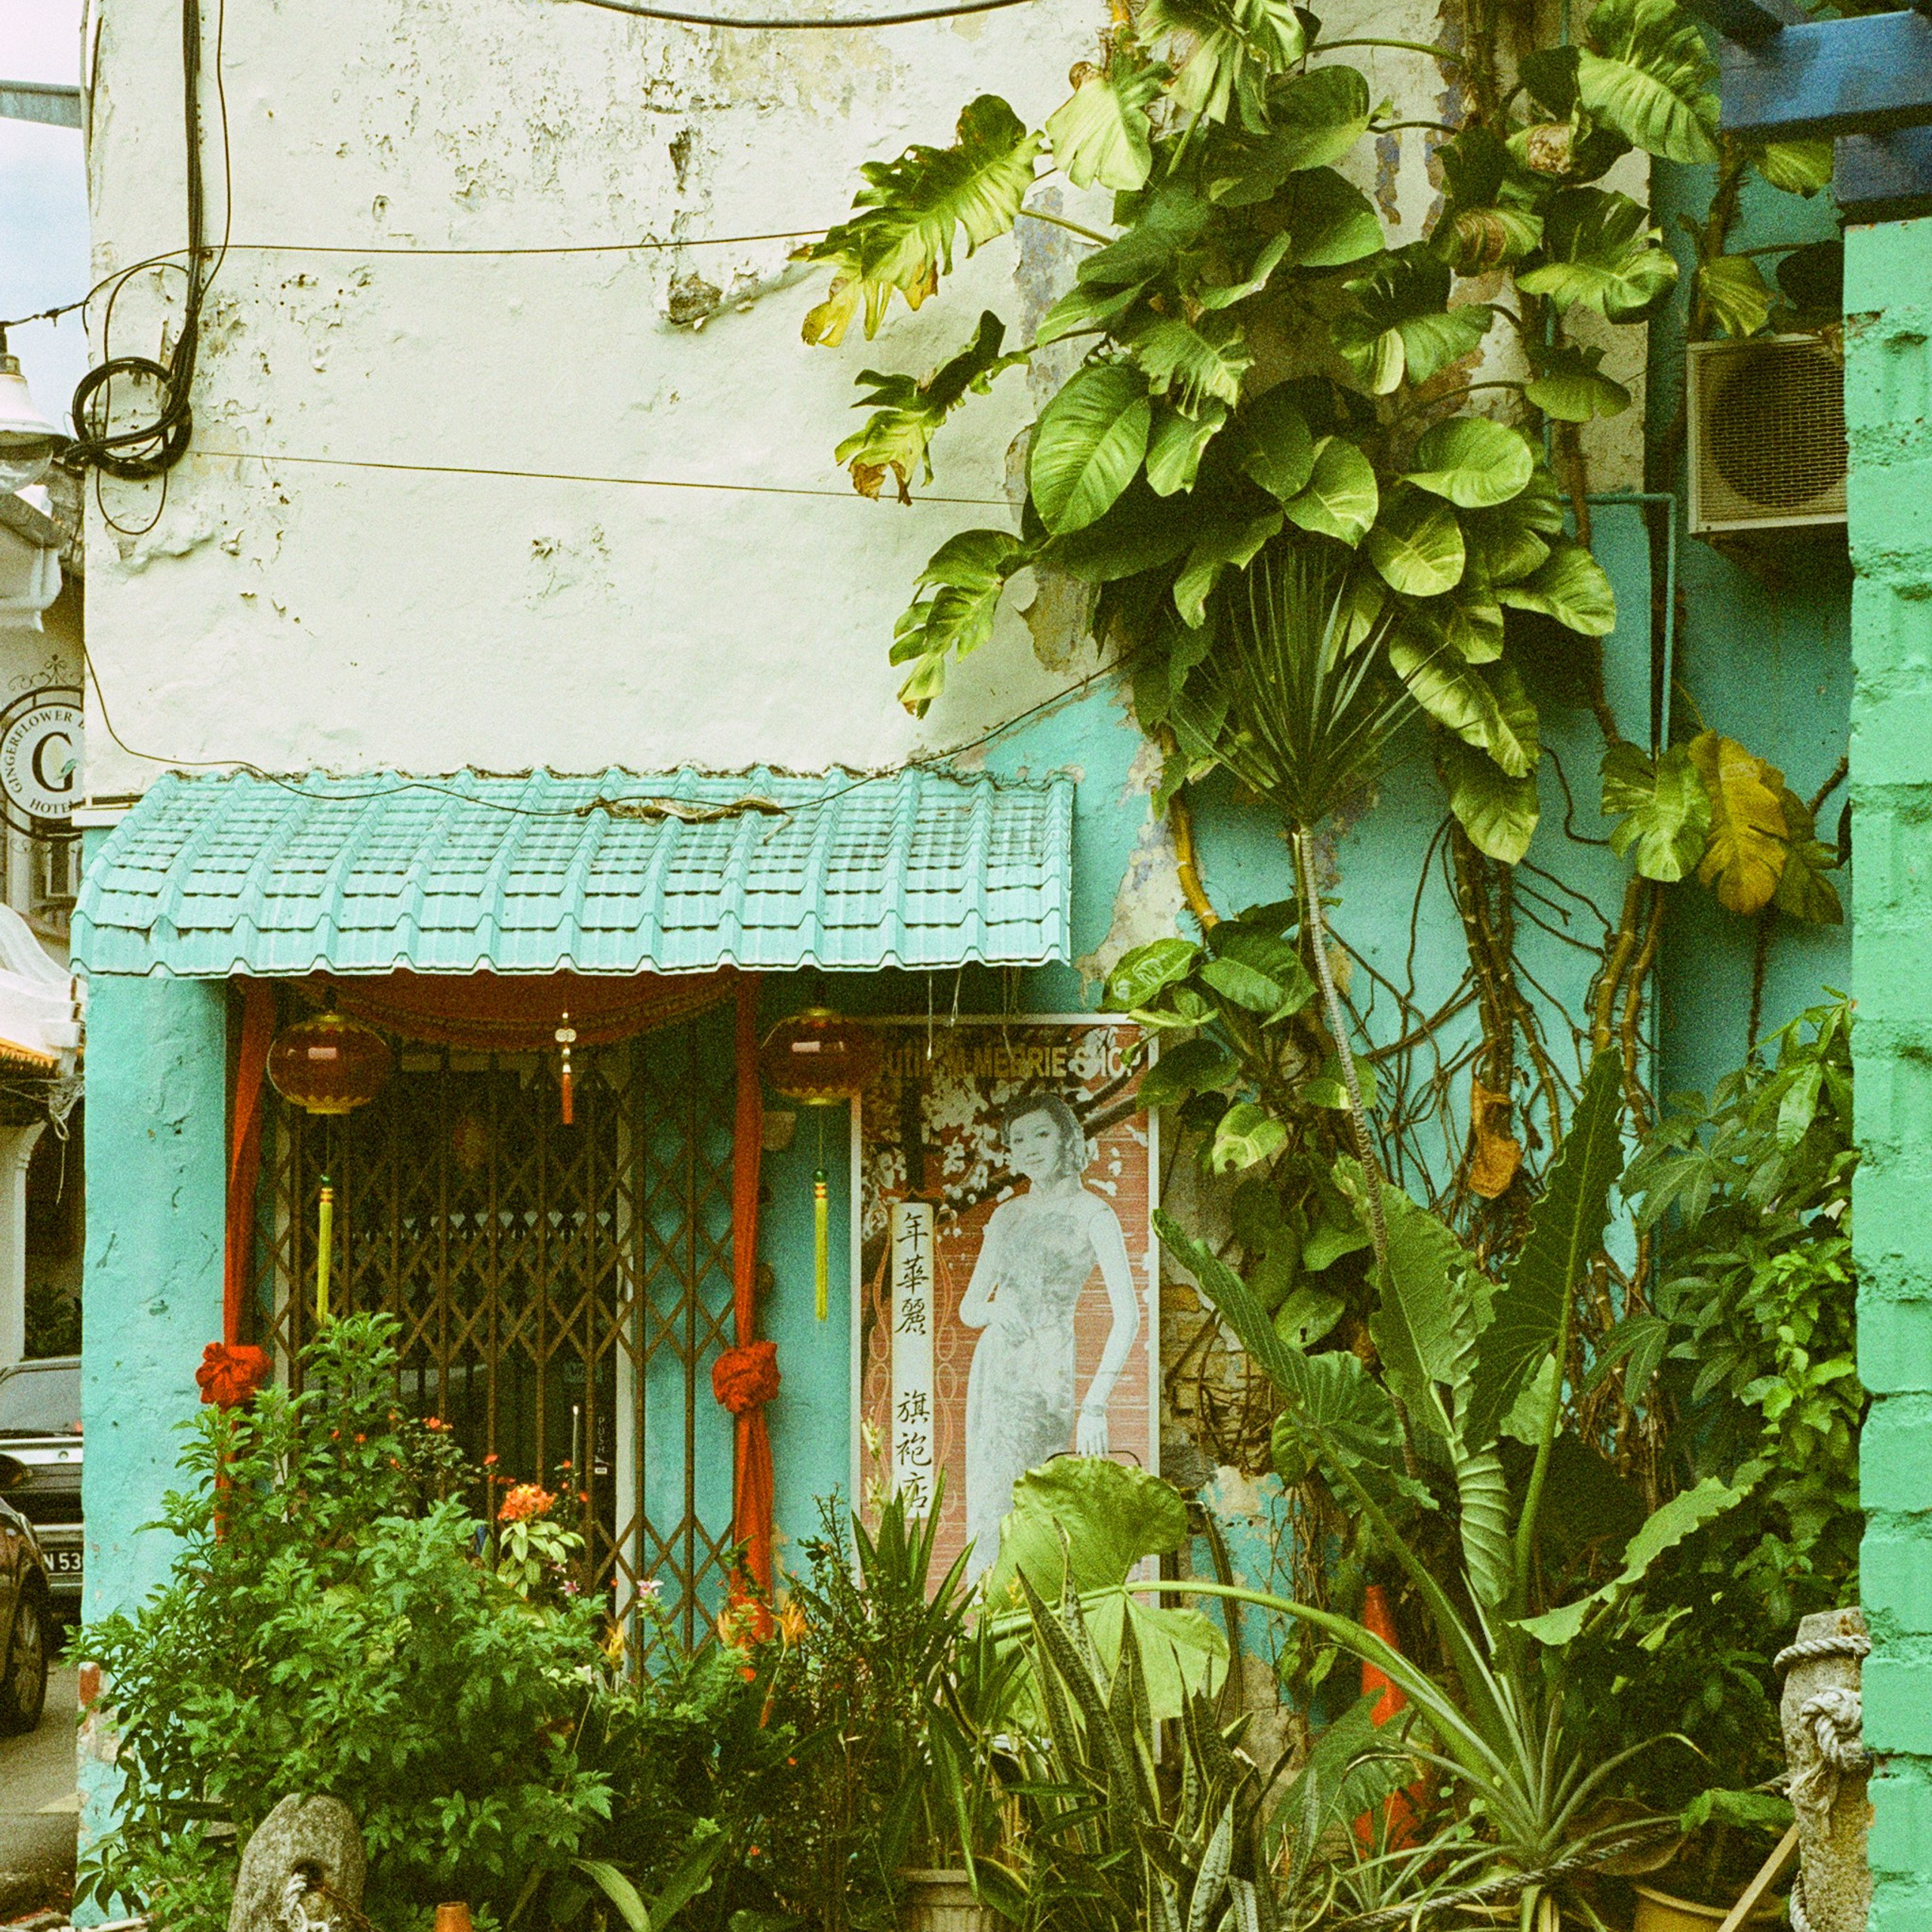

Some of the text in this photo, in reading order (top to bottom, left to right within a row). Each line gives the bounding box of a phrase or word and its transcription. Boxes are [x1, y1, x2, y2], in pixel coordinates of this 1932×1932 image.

[5, 710, 72, 793] GINGERFLOWER
[32, 731, 75, 792] G
[894, 1213, 933, 1509] 年華麗 旗袍店
[597, 1416, 606, 1455] PUSH
